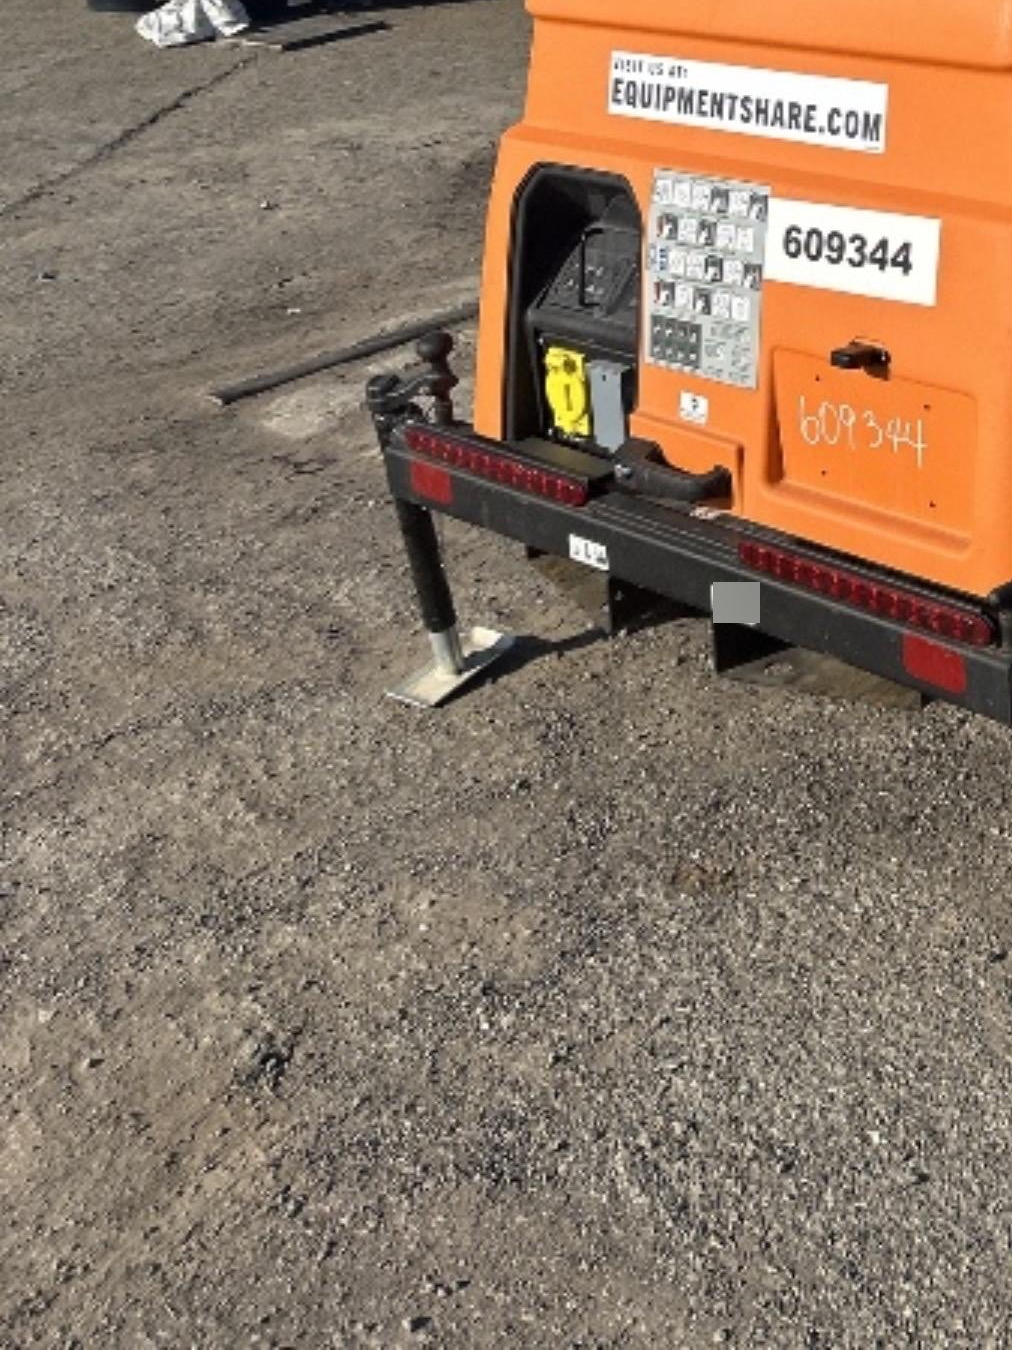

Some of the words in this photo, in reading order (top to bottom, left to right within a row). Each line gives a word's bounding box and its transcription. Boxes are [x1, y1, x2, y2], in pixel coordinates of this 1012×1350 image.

[611, 78, 882, 142] EQUIPMENTSHARE.COM
[783, 225, 912, 275] 609344
[799, 395, 927, 468] 609344
